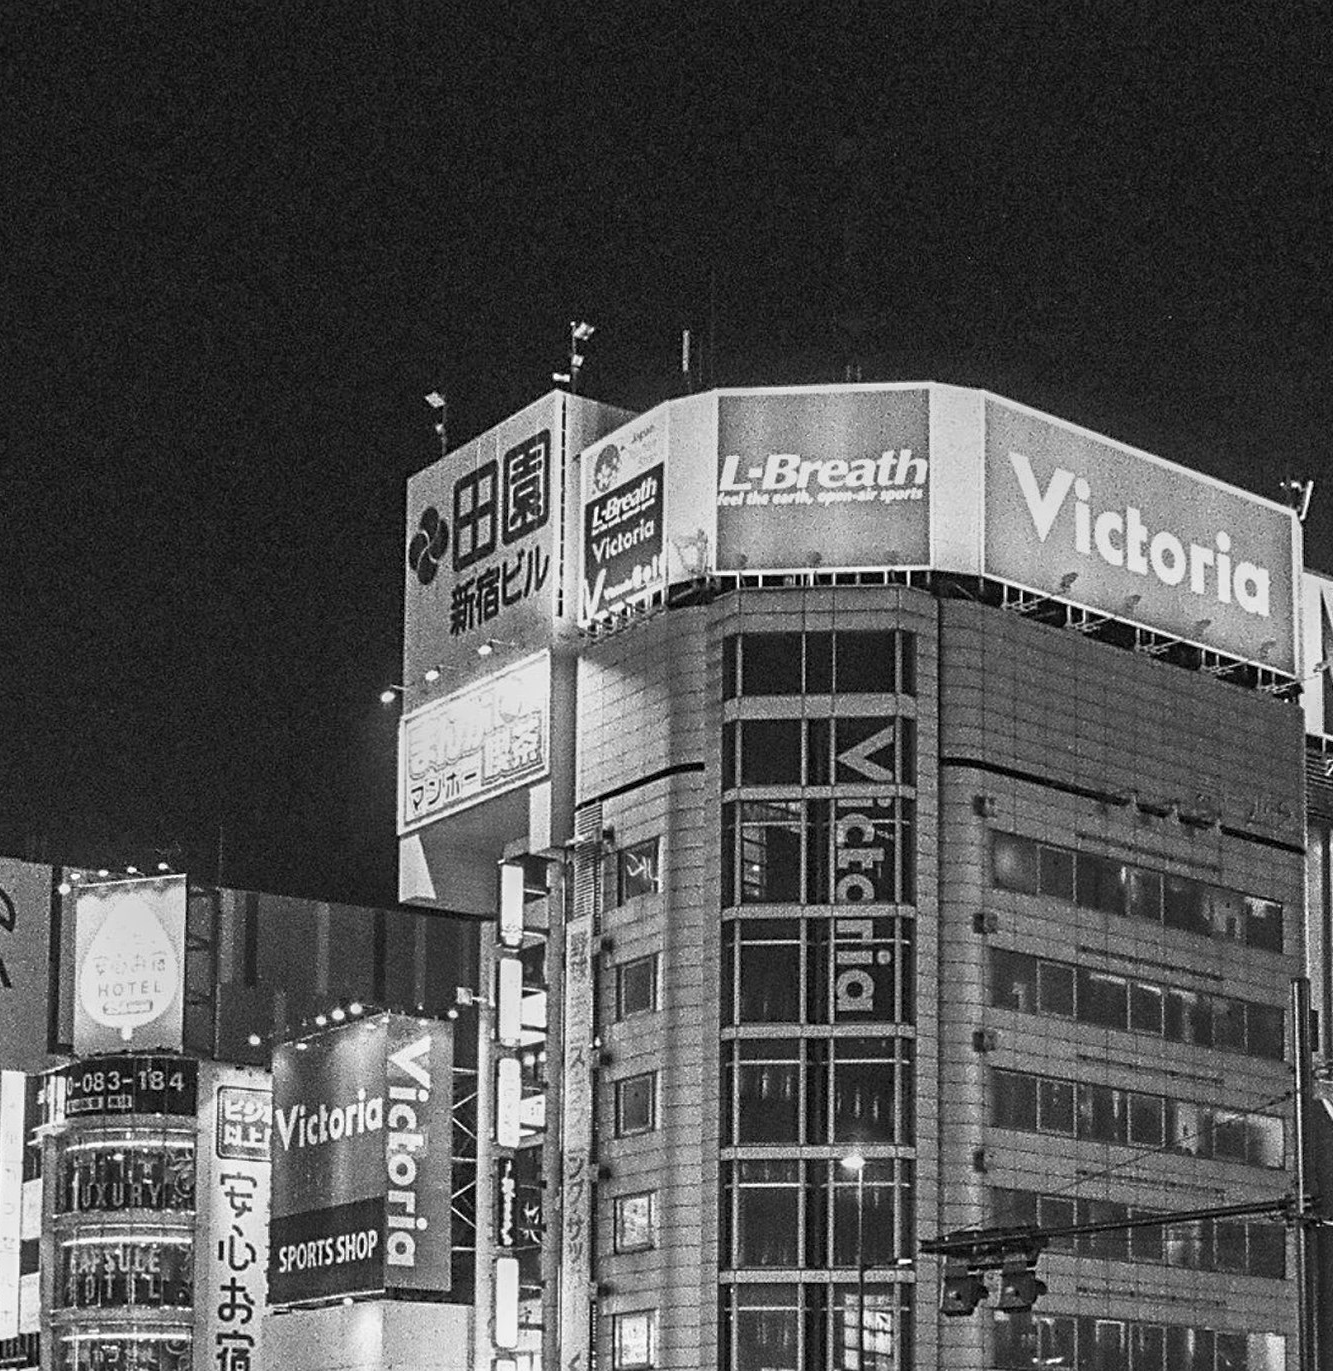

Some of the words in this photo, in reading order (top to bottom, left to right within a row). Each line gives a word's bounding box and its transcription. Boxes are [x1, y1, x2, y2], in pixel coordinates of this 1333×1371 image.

[719, 449, 929, 491] L-Breath
[592, 477, 657, 528] L-Breath
[592, 518, 655, 563] Victoria
[1009, 452, 1269, 617] Victoria
[449, 547, 550, 636] 新宿ビル
[836, 724, 895, 1012] Victoria
[98, 980, 161, 998] HOTEL
[275, 1089, 383, 1151] Victoria
[388, 1036, 434, 1267] Victoria
[278, 1238, 333, 1274] SPORTS
[335, 1230, 378, 1262] SHOP
